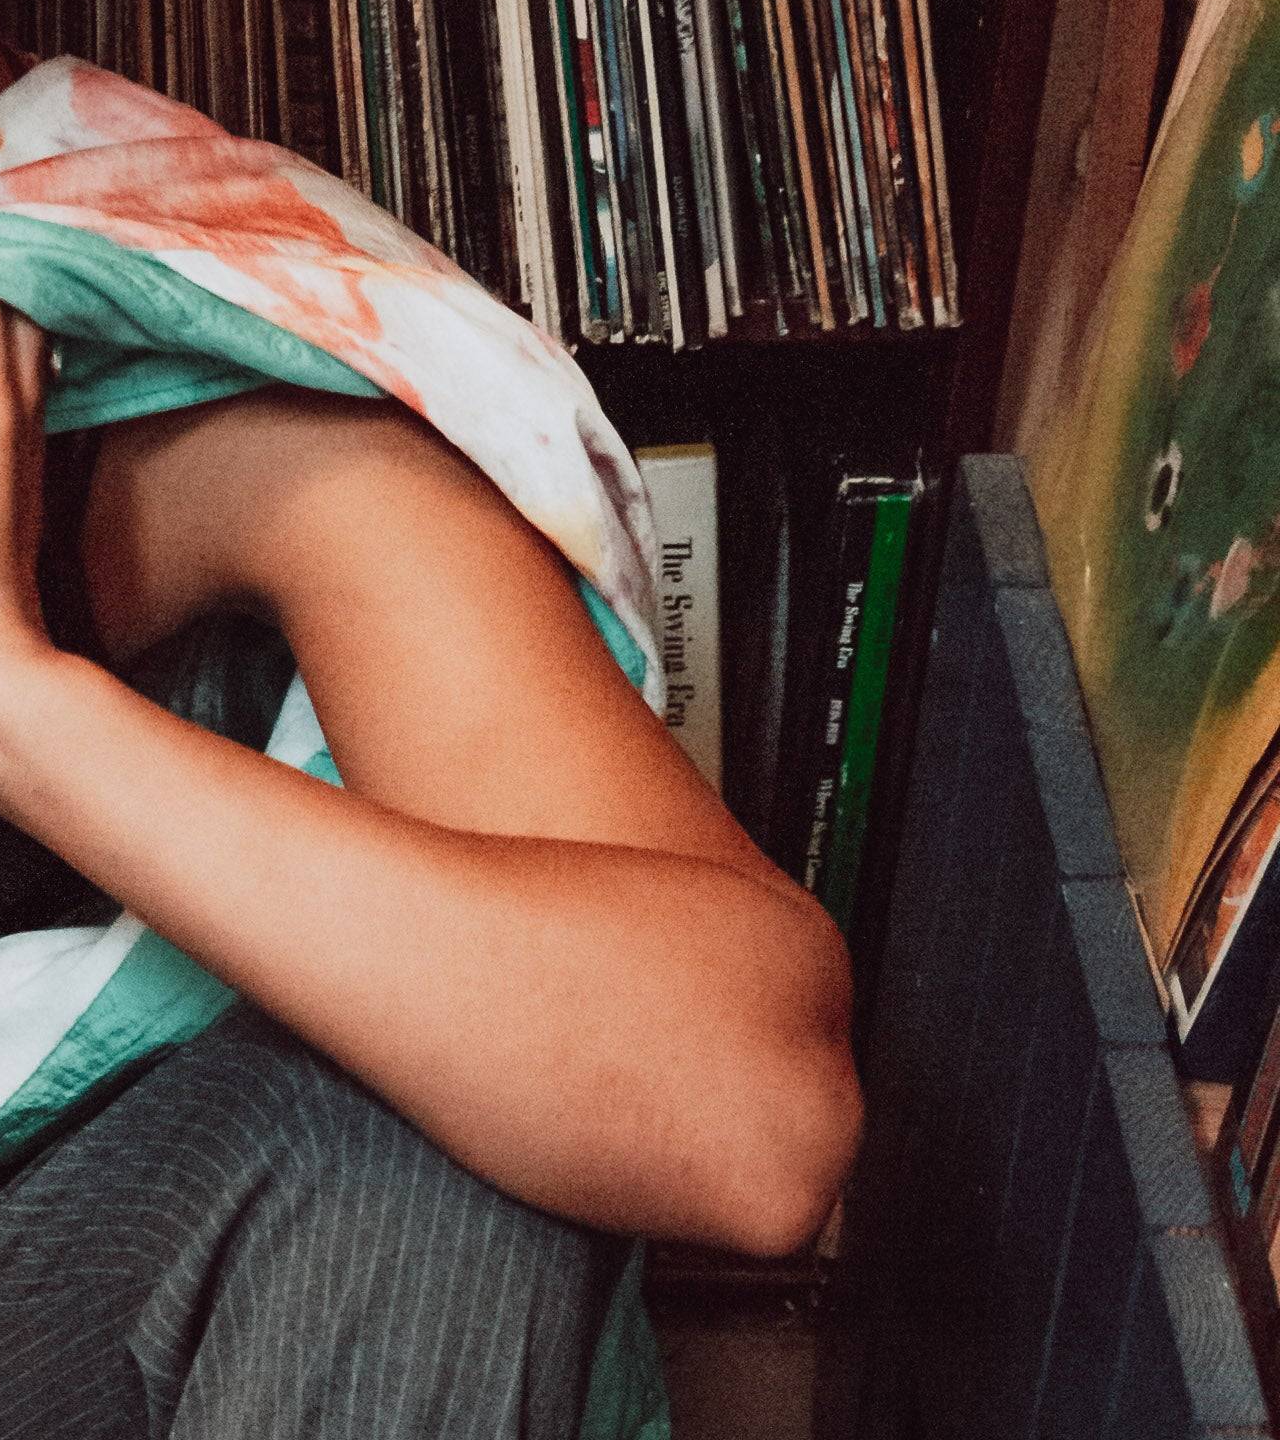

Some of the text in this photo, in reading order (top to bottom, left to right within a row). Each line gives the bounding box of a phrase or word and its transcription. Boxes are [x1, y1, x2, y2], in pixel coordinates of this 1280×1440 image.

[662, 537, 697, 728] The Swing Era
[837, 582, 865, 670] The Swing Era
